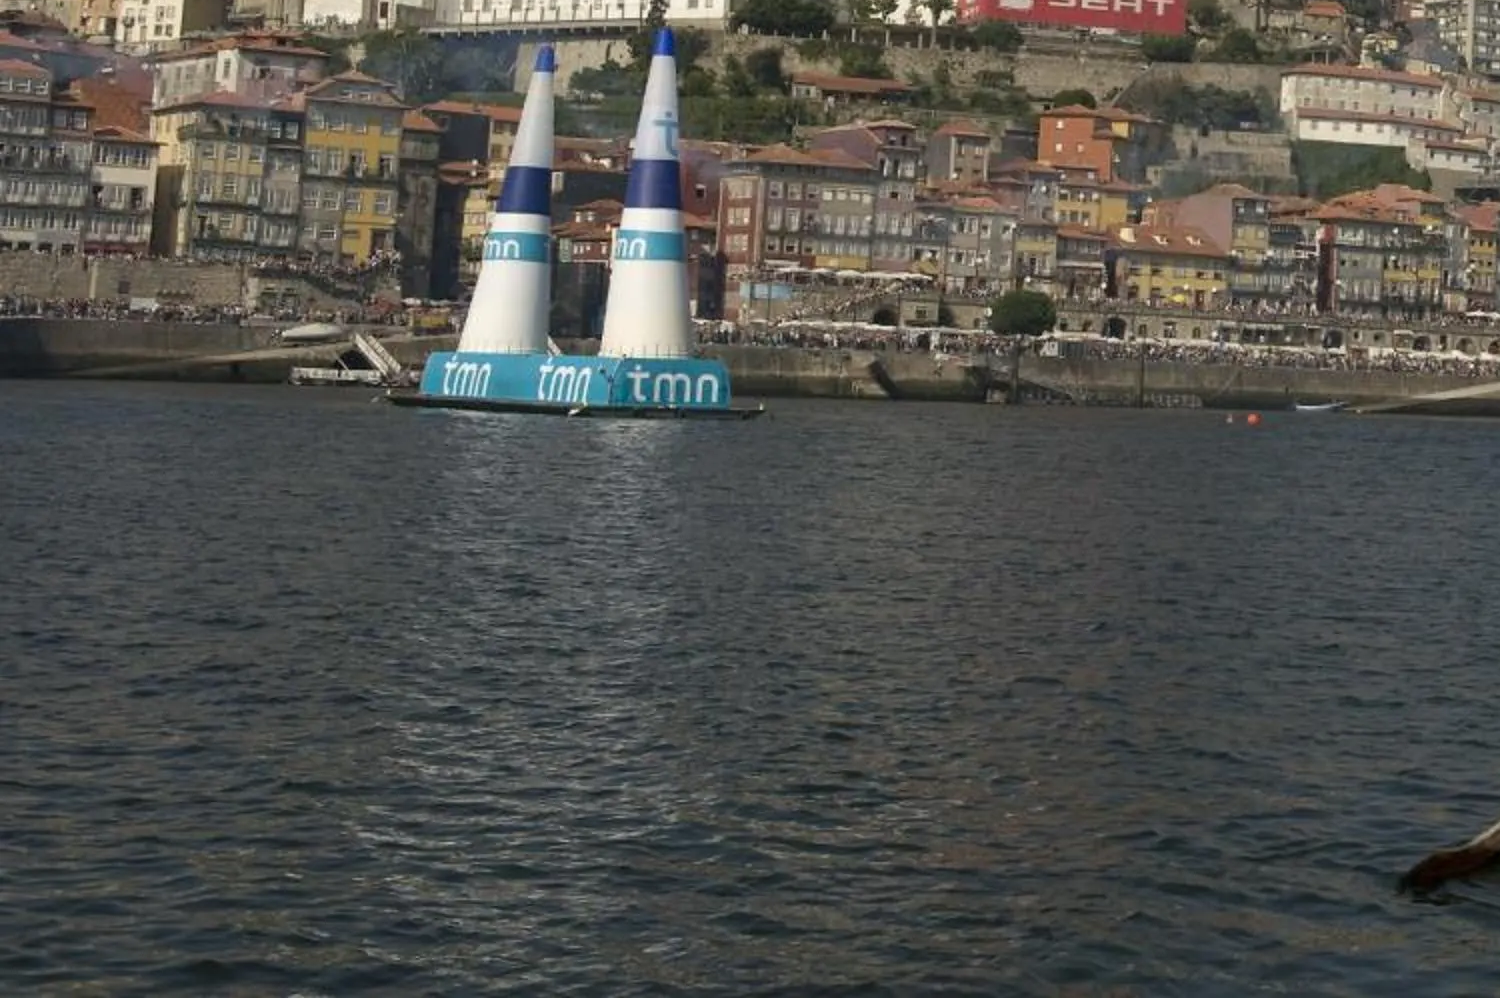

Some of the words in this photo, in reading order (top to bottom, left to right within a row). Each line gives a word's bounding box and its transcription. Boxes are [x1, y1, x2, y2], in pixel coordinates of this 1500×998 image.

[484, 238, 520, 259] mn
[616, 237, 647, 259] mn
[442, 354, 492, 397] tmn
[536, 355, 593, 405] tmn
[627, 363, 719, 408] tmn
